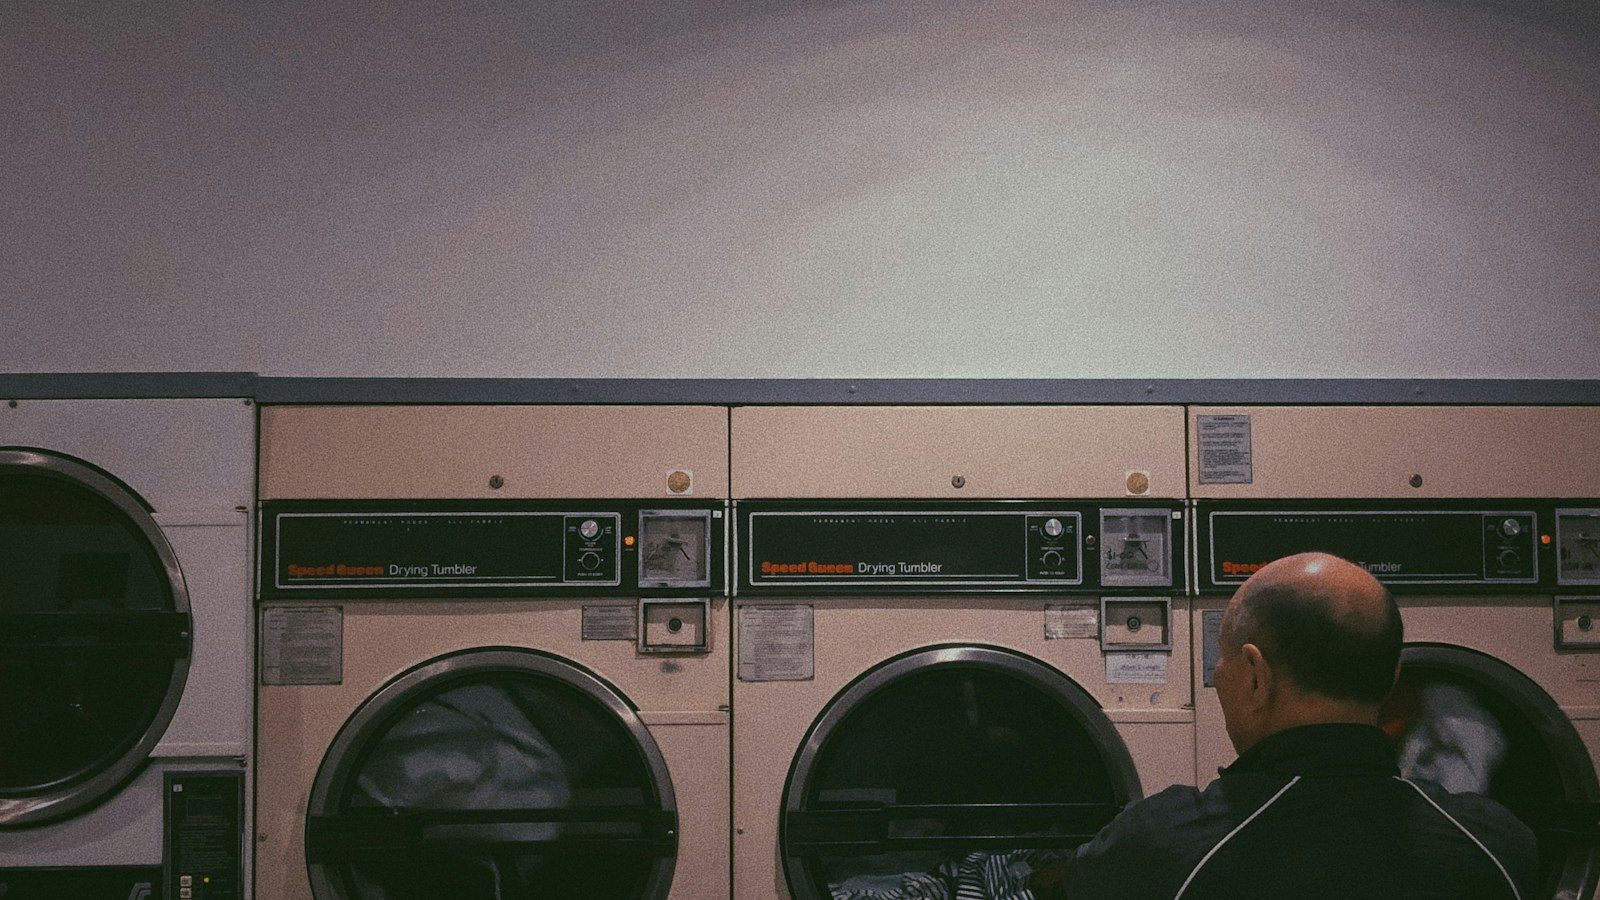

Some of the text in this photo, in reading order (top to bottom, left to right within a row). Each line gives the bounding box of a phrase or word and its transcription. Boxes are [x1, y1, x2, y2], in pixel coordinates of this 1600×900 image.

[287, 563, 335, 577] Speed
[389, 564, 428, 577] Drying
[431, 563, 477, 575] Tumbler
[761, 561, 942, 575] Speed Queen Drying Tumbler
[1358, 561, 1402, 572] Tumbler
